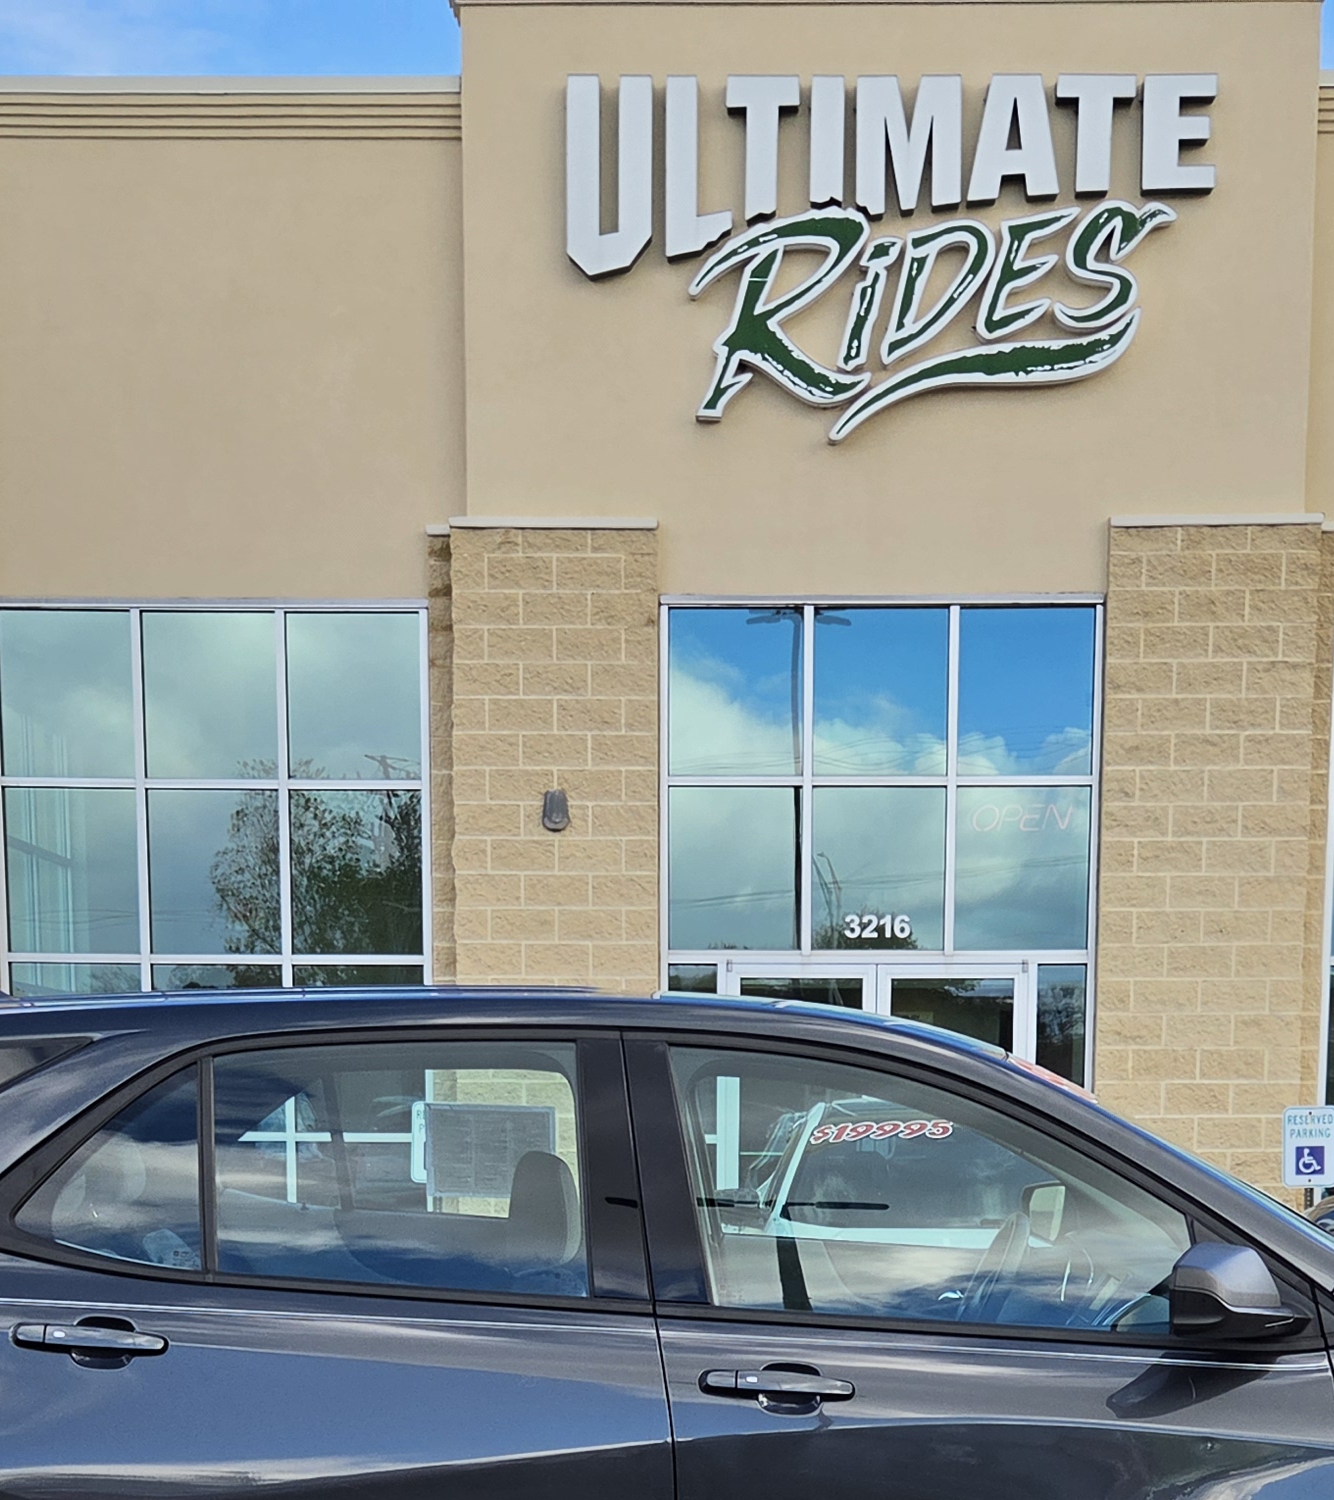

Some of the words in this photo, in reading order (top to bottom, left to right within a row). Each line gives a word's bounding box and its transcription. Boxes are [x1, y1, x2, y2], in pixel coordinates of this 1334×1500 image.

[565, 73, 1218, 280] ULTIMATE
[844, 914, 911, 939] 3216
[1287, 1113, 1334, 1126] RESERVED
[810, 1120, 954, 1145] $19995
[1289, 1127, 1332, 1139] PARKING
